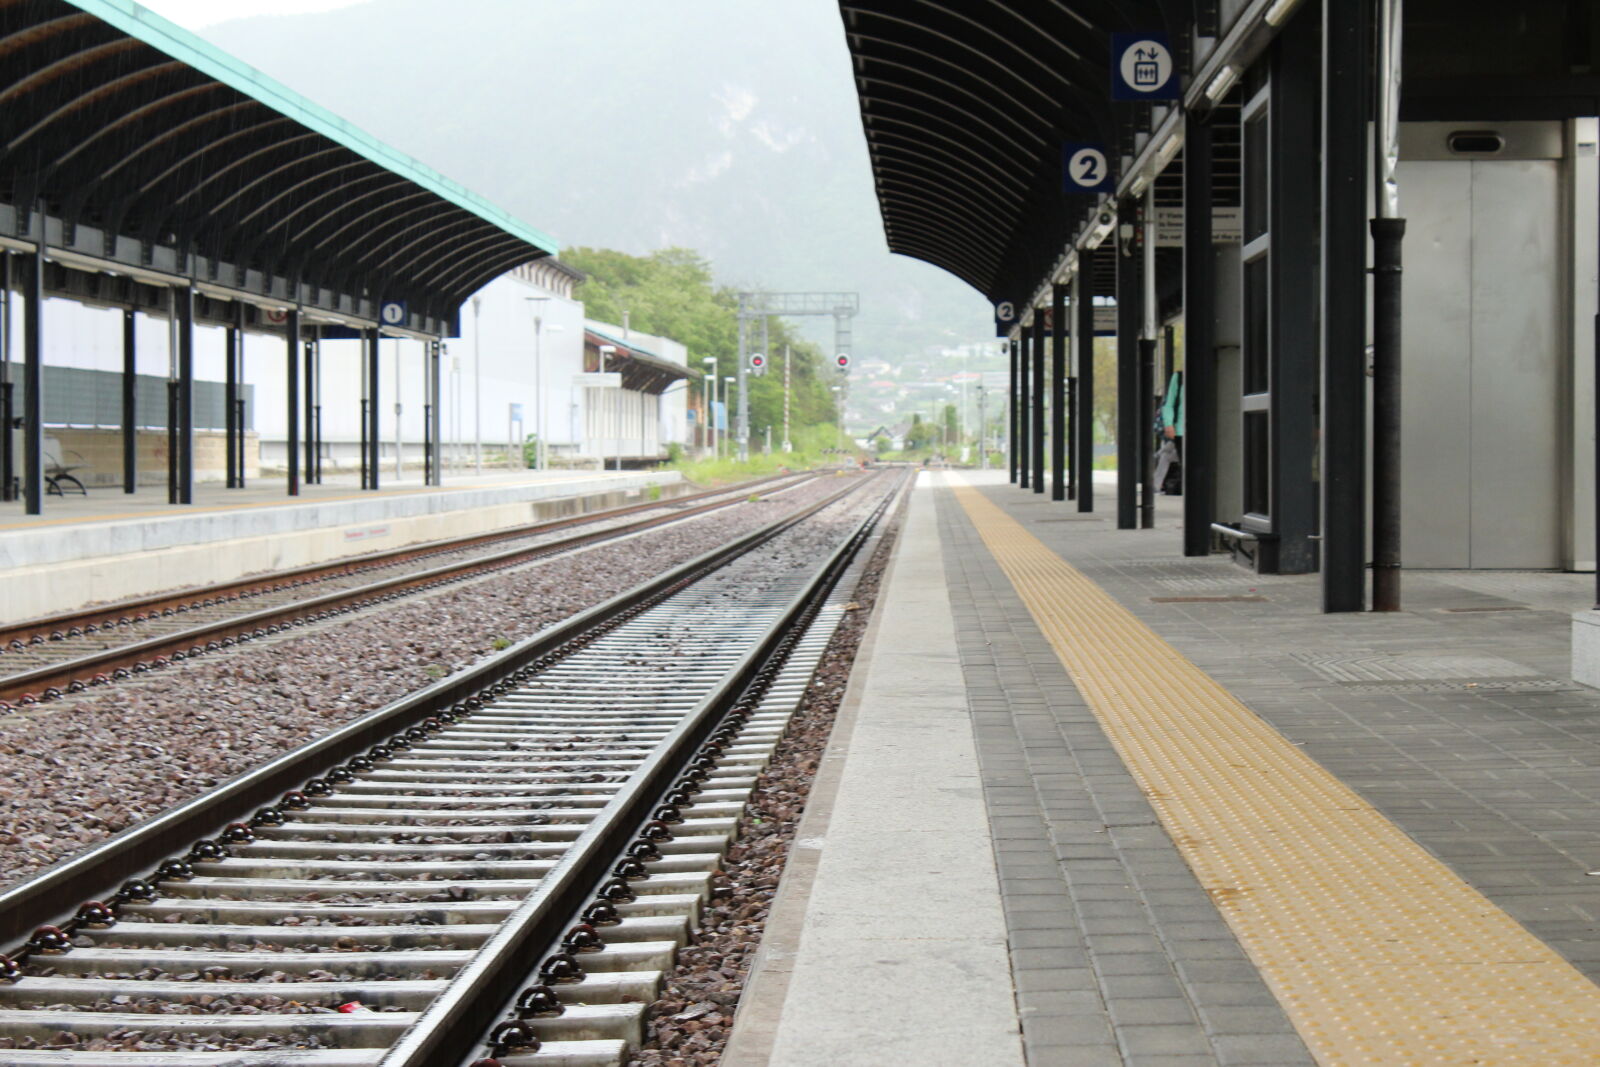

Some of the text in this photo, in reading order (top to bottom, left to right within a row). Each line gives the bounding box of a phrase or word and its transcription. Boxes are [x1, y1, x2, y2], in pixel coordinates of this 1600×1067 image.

[1079, 155, 1098, 180] 2
[390, 307, 396, 320] 1
[1002, 305, 1011, 318] 2
